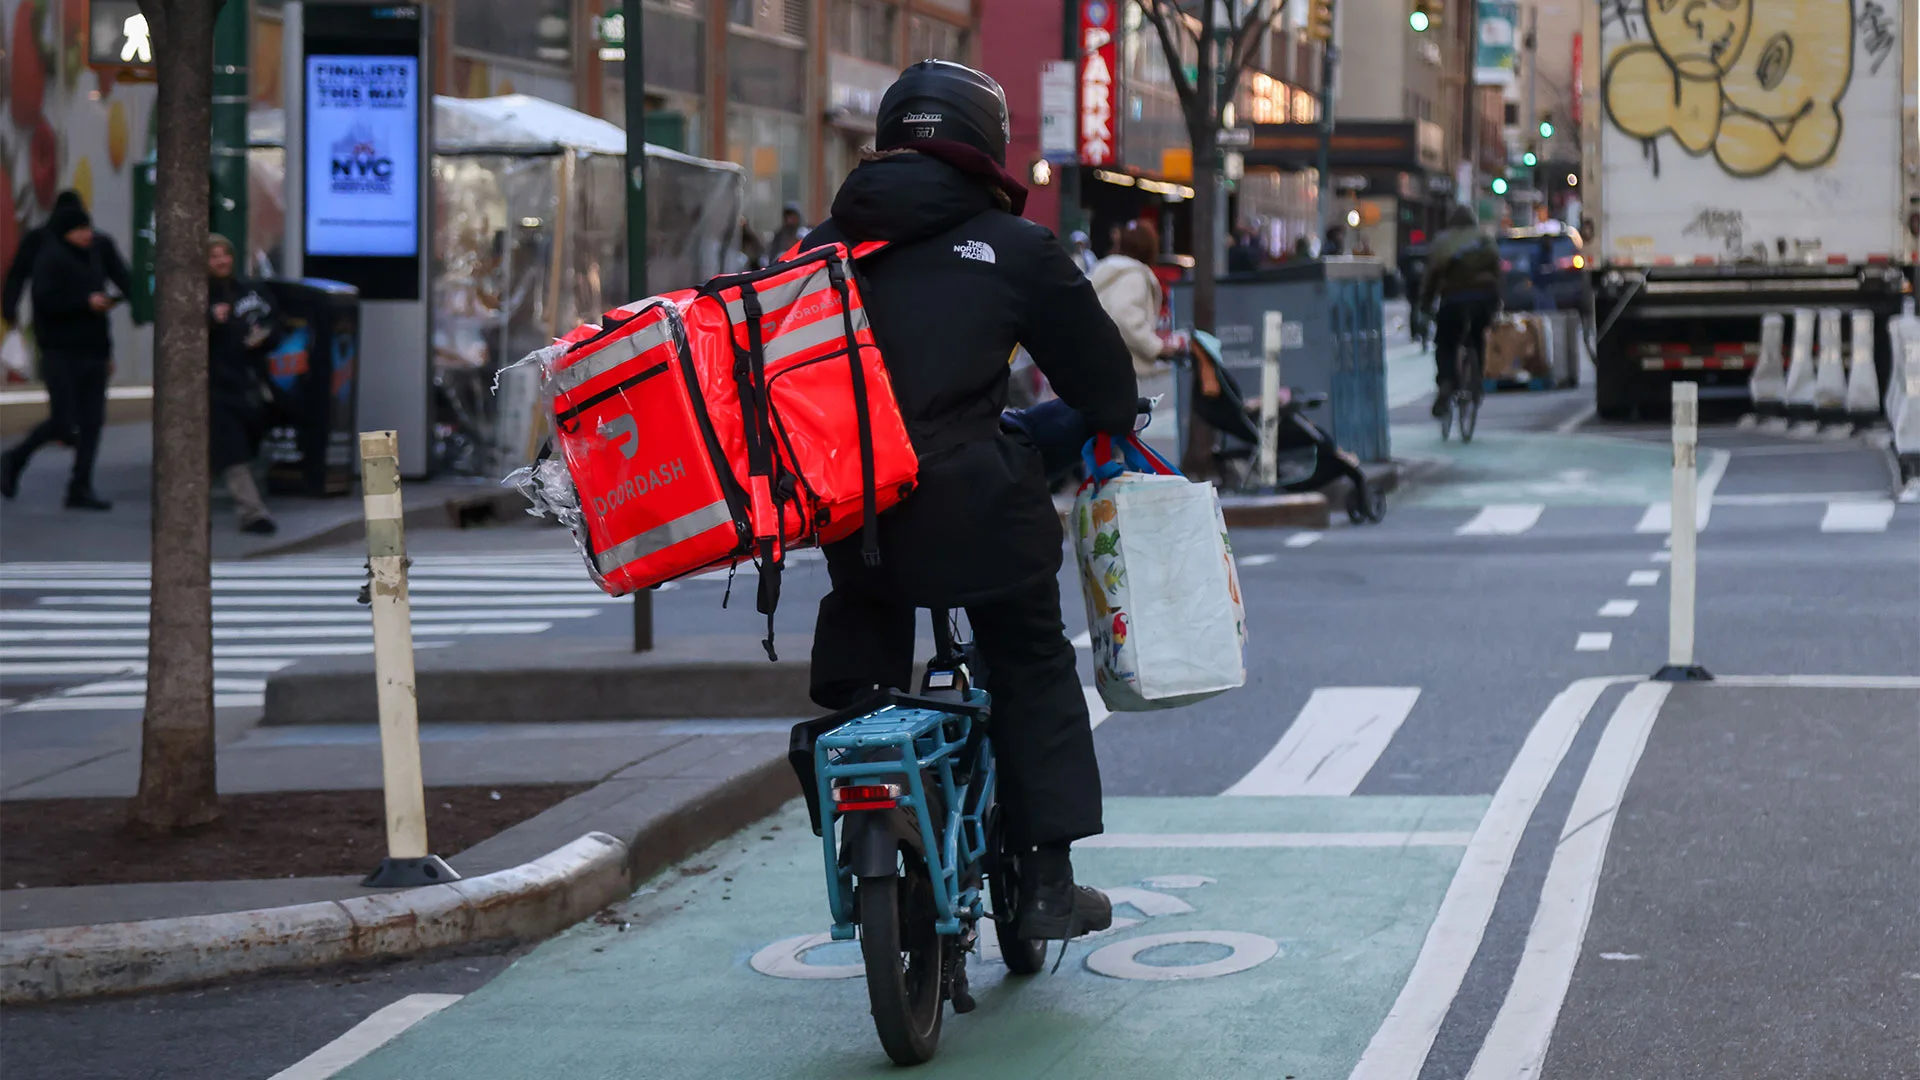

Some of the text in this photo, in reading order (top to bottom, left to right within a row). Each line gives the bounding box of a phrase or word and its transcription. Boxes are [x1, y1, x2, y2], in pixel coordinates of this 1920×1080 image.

[317, 65, 409, 76] FINALISTS
[1082, 26, 1112, 141] PARK
[319, 87, 407, 99] THIS WAY
[331, 158, 394, 177] NYC
[953, 245, 983, 255] NORTH
[966, 240, 984, 249] THE
[961, 252, 983, 260] FACE
[593, 458, 686, 517] DOORDASH
